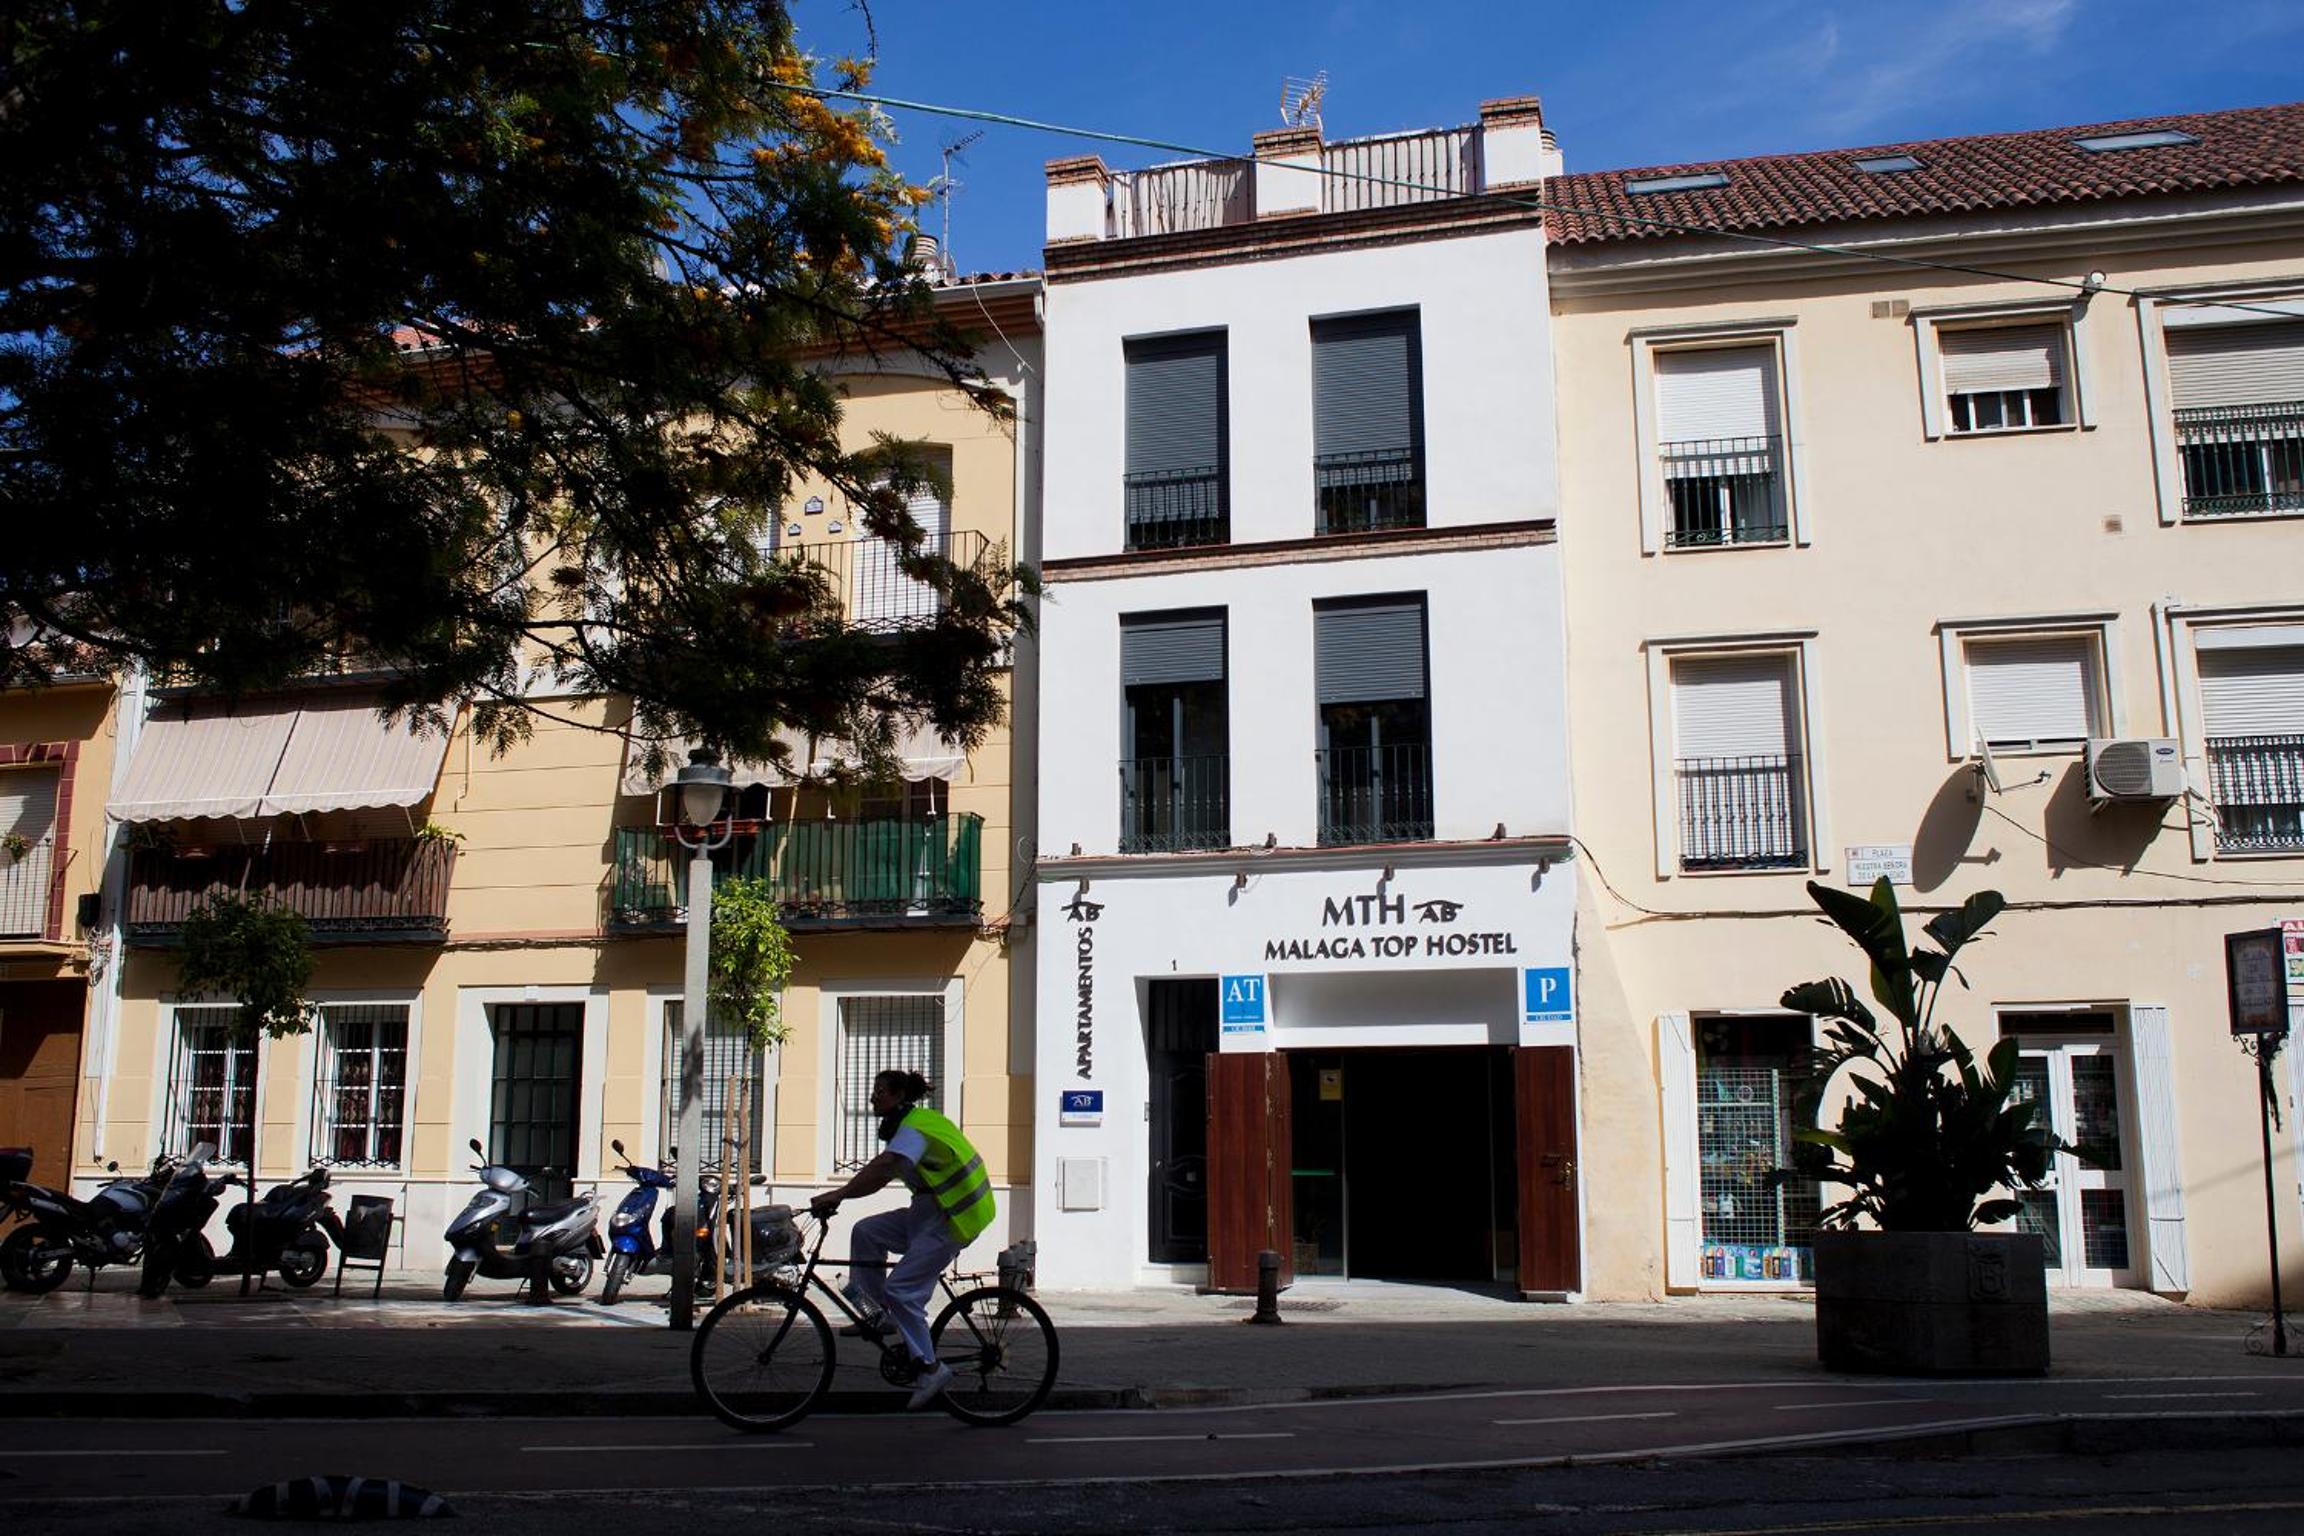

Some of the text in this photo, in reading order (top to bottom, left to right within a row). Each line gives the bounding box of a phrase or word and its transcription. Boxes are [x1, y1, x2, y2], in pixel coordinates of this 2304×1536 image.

[1322, 893, 1405, 927] MTH
[1265, 932, 1517, 960] MALAGA TOP HOSTEL
[1171, 959, 1178, 971] 1
[1226, 978, 1260, 1002] AT
[1540, 977, 1557, 1003] P
[1077, 926, 1094, 1081] APARTAMENTOS
[1071, 1094, 1094, 1107] AB
